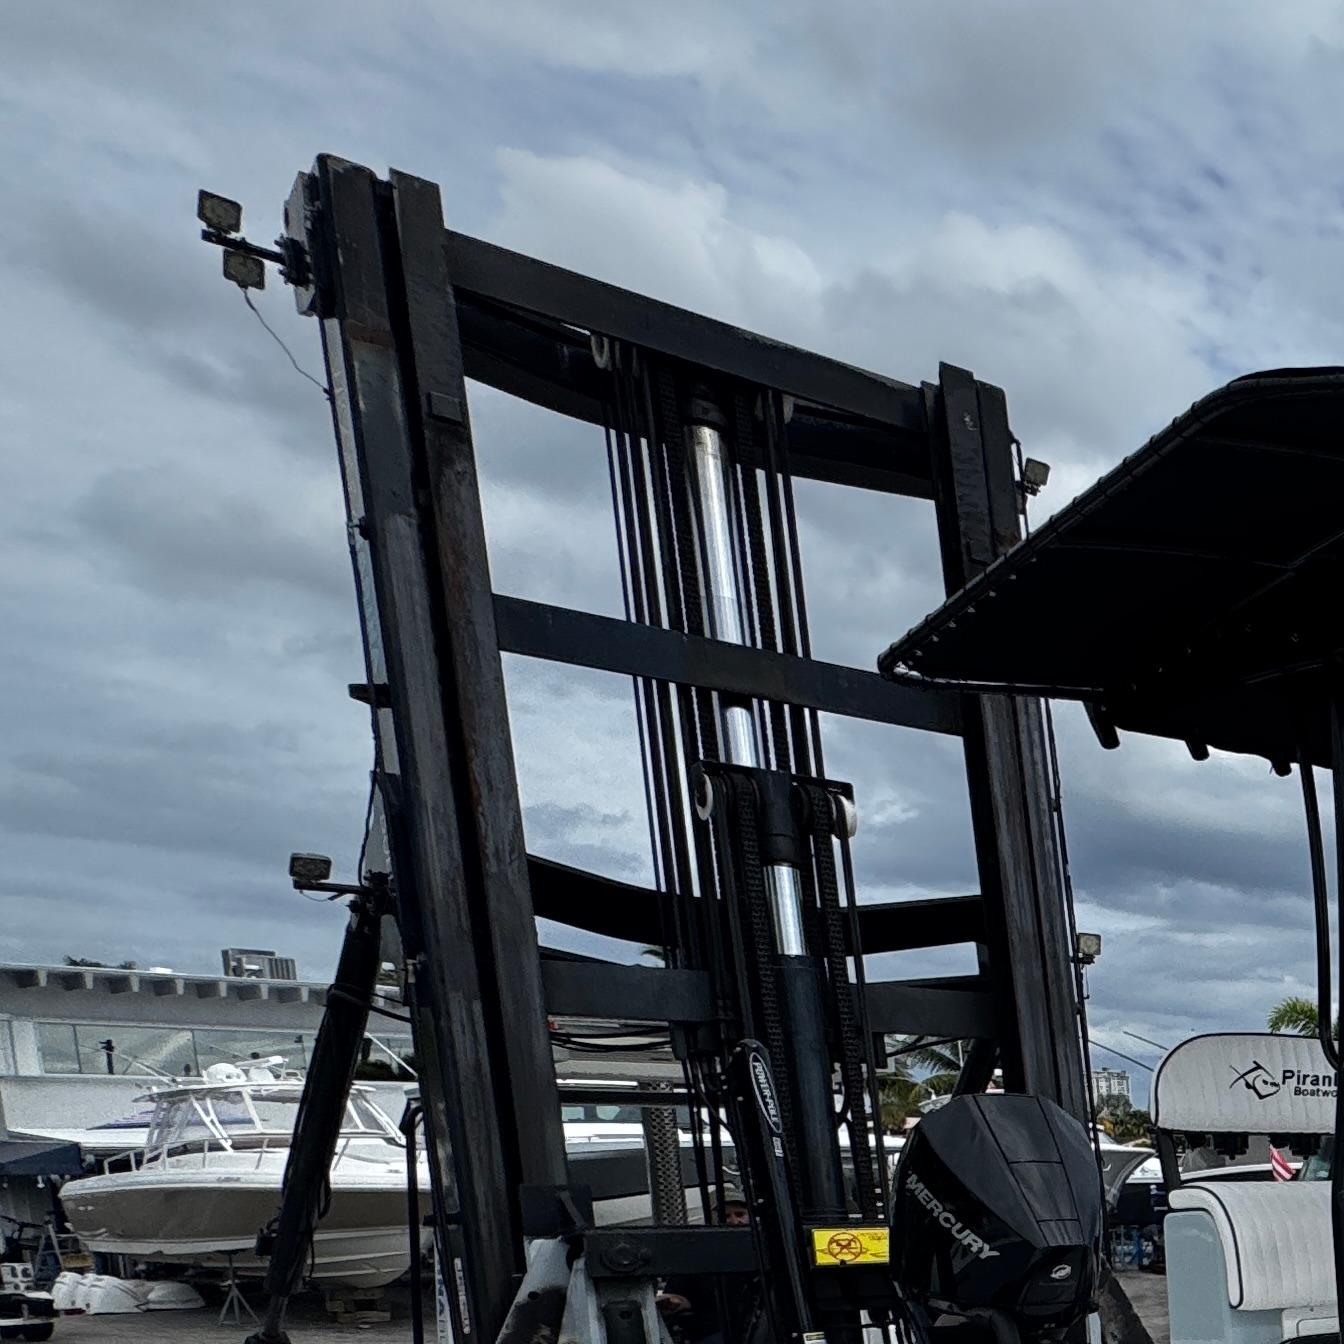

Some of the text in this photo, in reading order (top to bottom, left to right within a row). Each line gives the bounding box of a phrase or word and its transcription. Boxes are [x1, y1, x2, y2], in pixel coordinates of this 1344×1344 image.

[1282, 1070, 1338, 1088] Piran
[1294, 1086, 1338, 1098] Boatwo
[906, 1173, 1001, 1259] MERCURY
